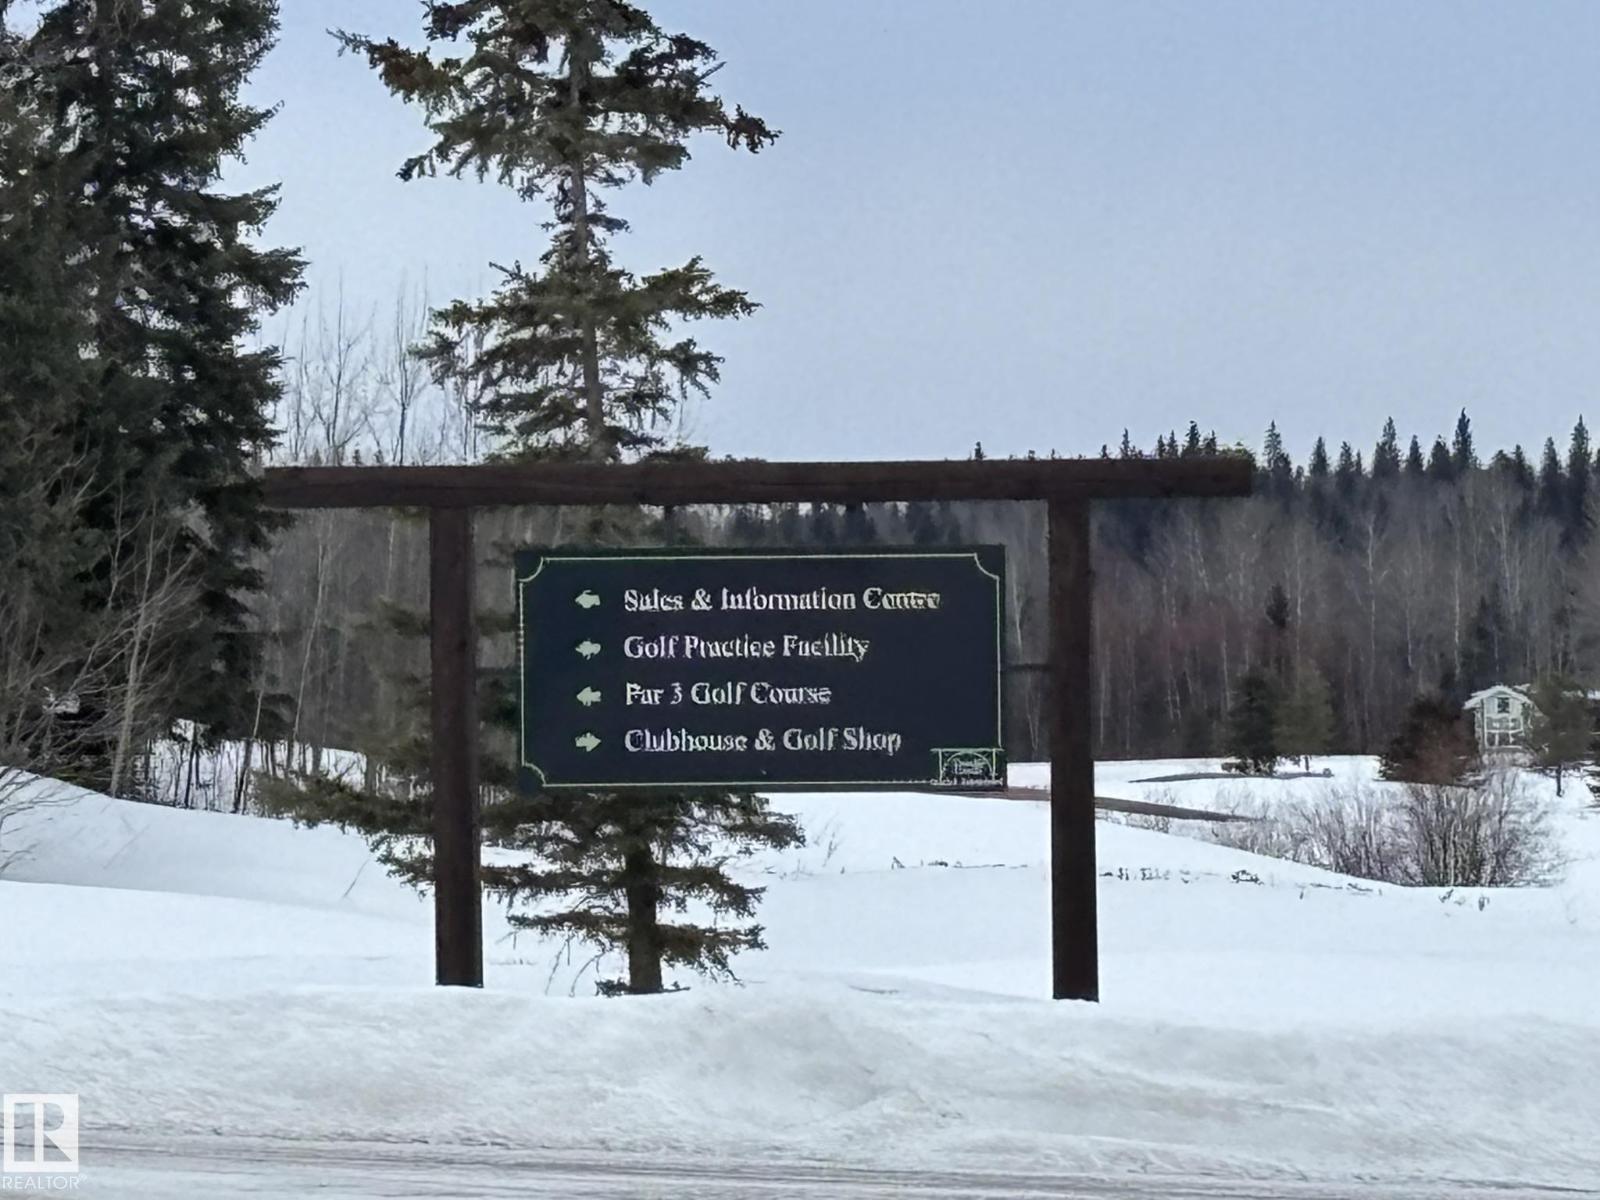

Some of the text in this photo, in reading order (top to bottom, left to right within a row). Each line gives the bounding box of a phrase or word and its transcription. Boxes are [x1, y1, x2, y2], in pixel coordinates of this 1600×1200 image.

[691, 588, 713, 611] &
[721, 586, 856, 611] Information
[623, 632, 869, 662] Golf Practice Facility
[626, 682, 832, 706] Par 3 Golf Course
[624, 726, 902, 757] Clubhouse & Golf Shop
